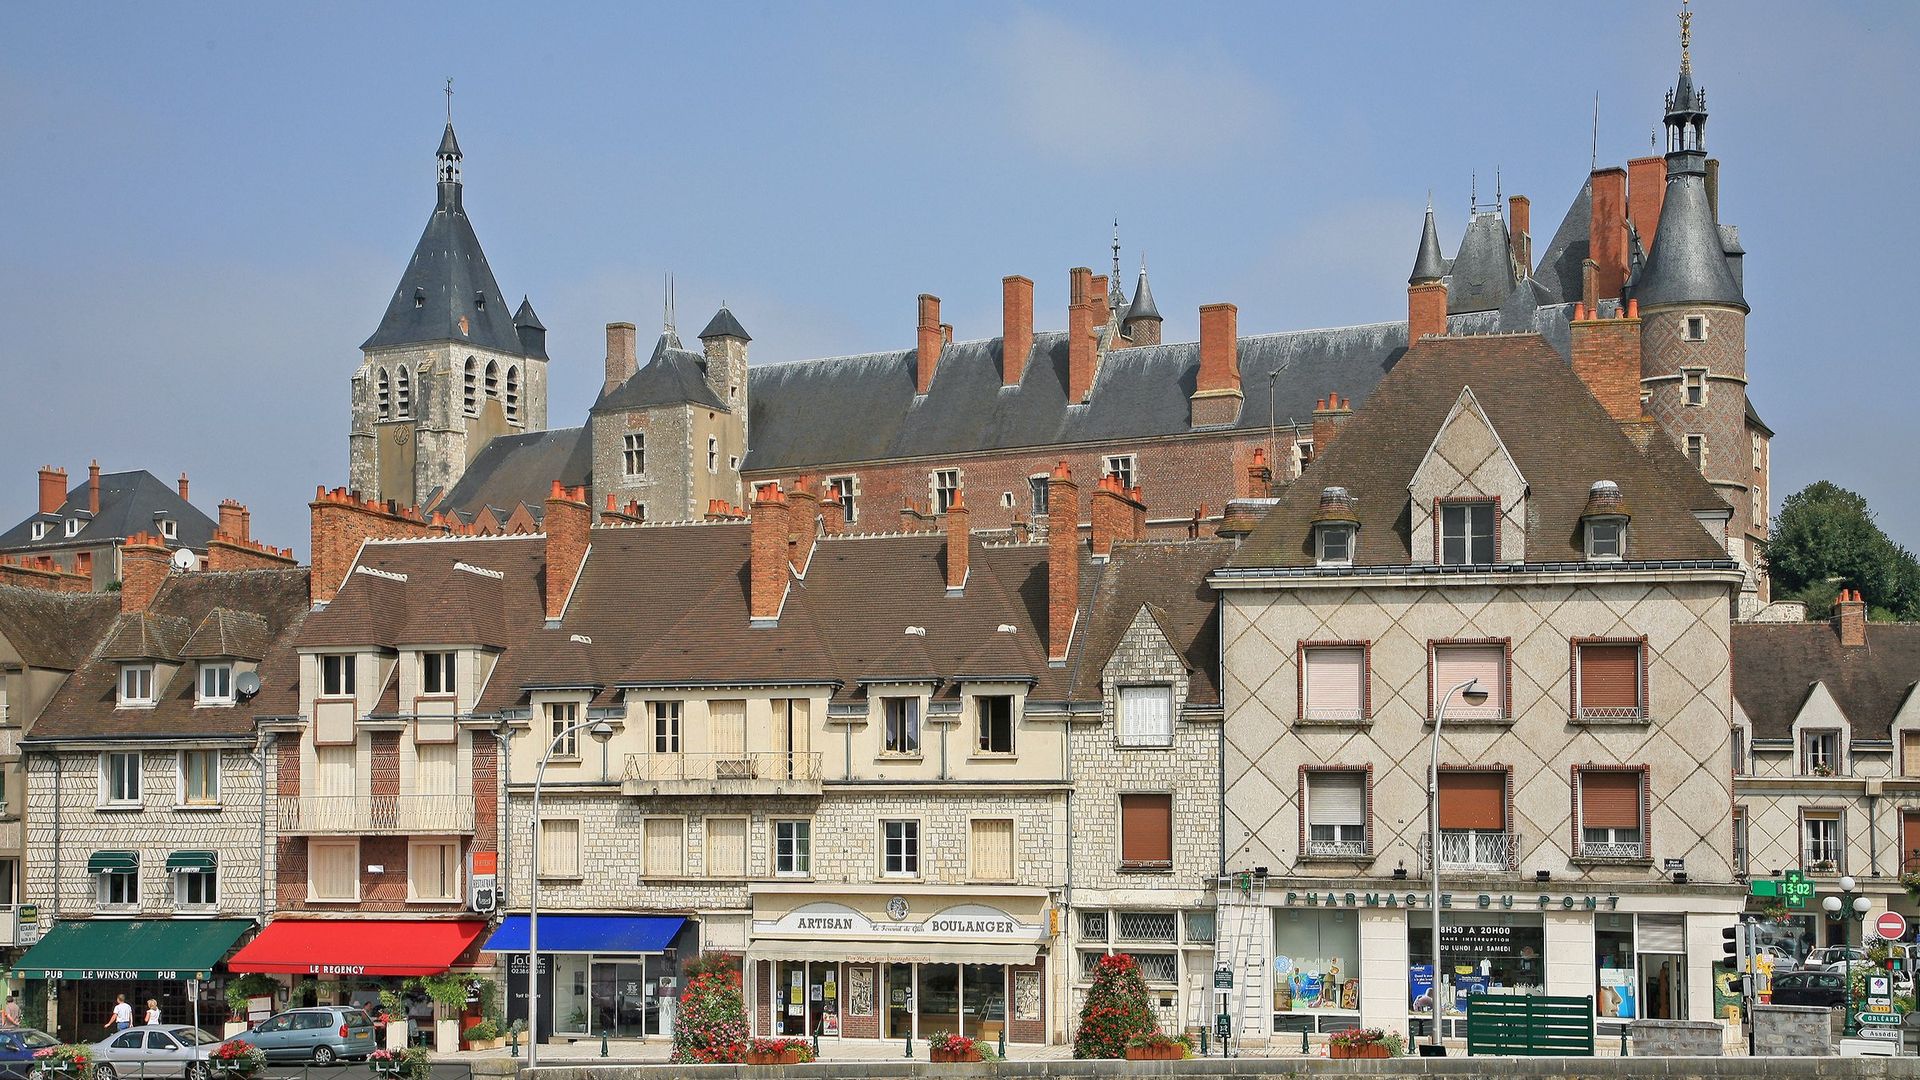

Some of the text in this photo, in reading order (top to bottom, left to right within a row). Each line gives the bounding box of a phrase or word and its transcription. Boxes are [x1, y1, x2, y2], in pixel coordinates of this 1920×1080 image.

[1782, 884, 1810, 894] 13:02
[1286, 892, 1619, 909] PHARMACIE DU PONT
[798, 918, 852, 929] ARTISAN
[932, 920, 1014, 932] BOULANGER
[310, 965, 364, 974] LE REGENCY
